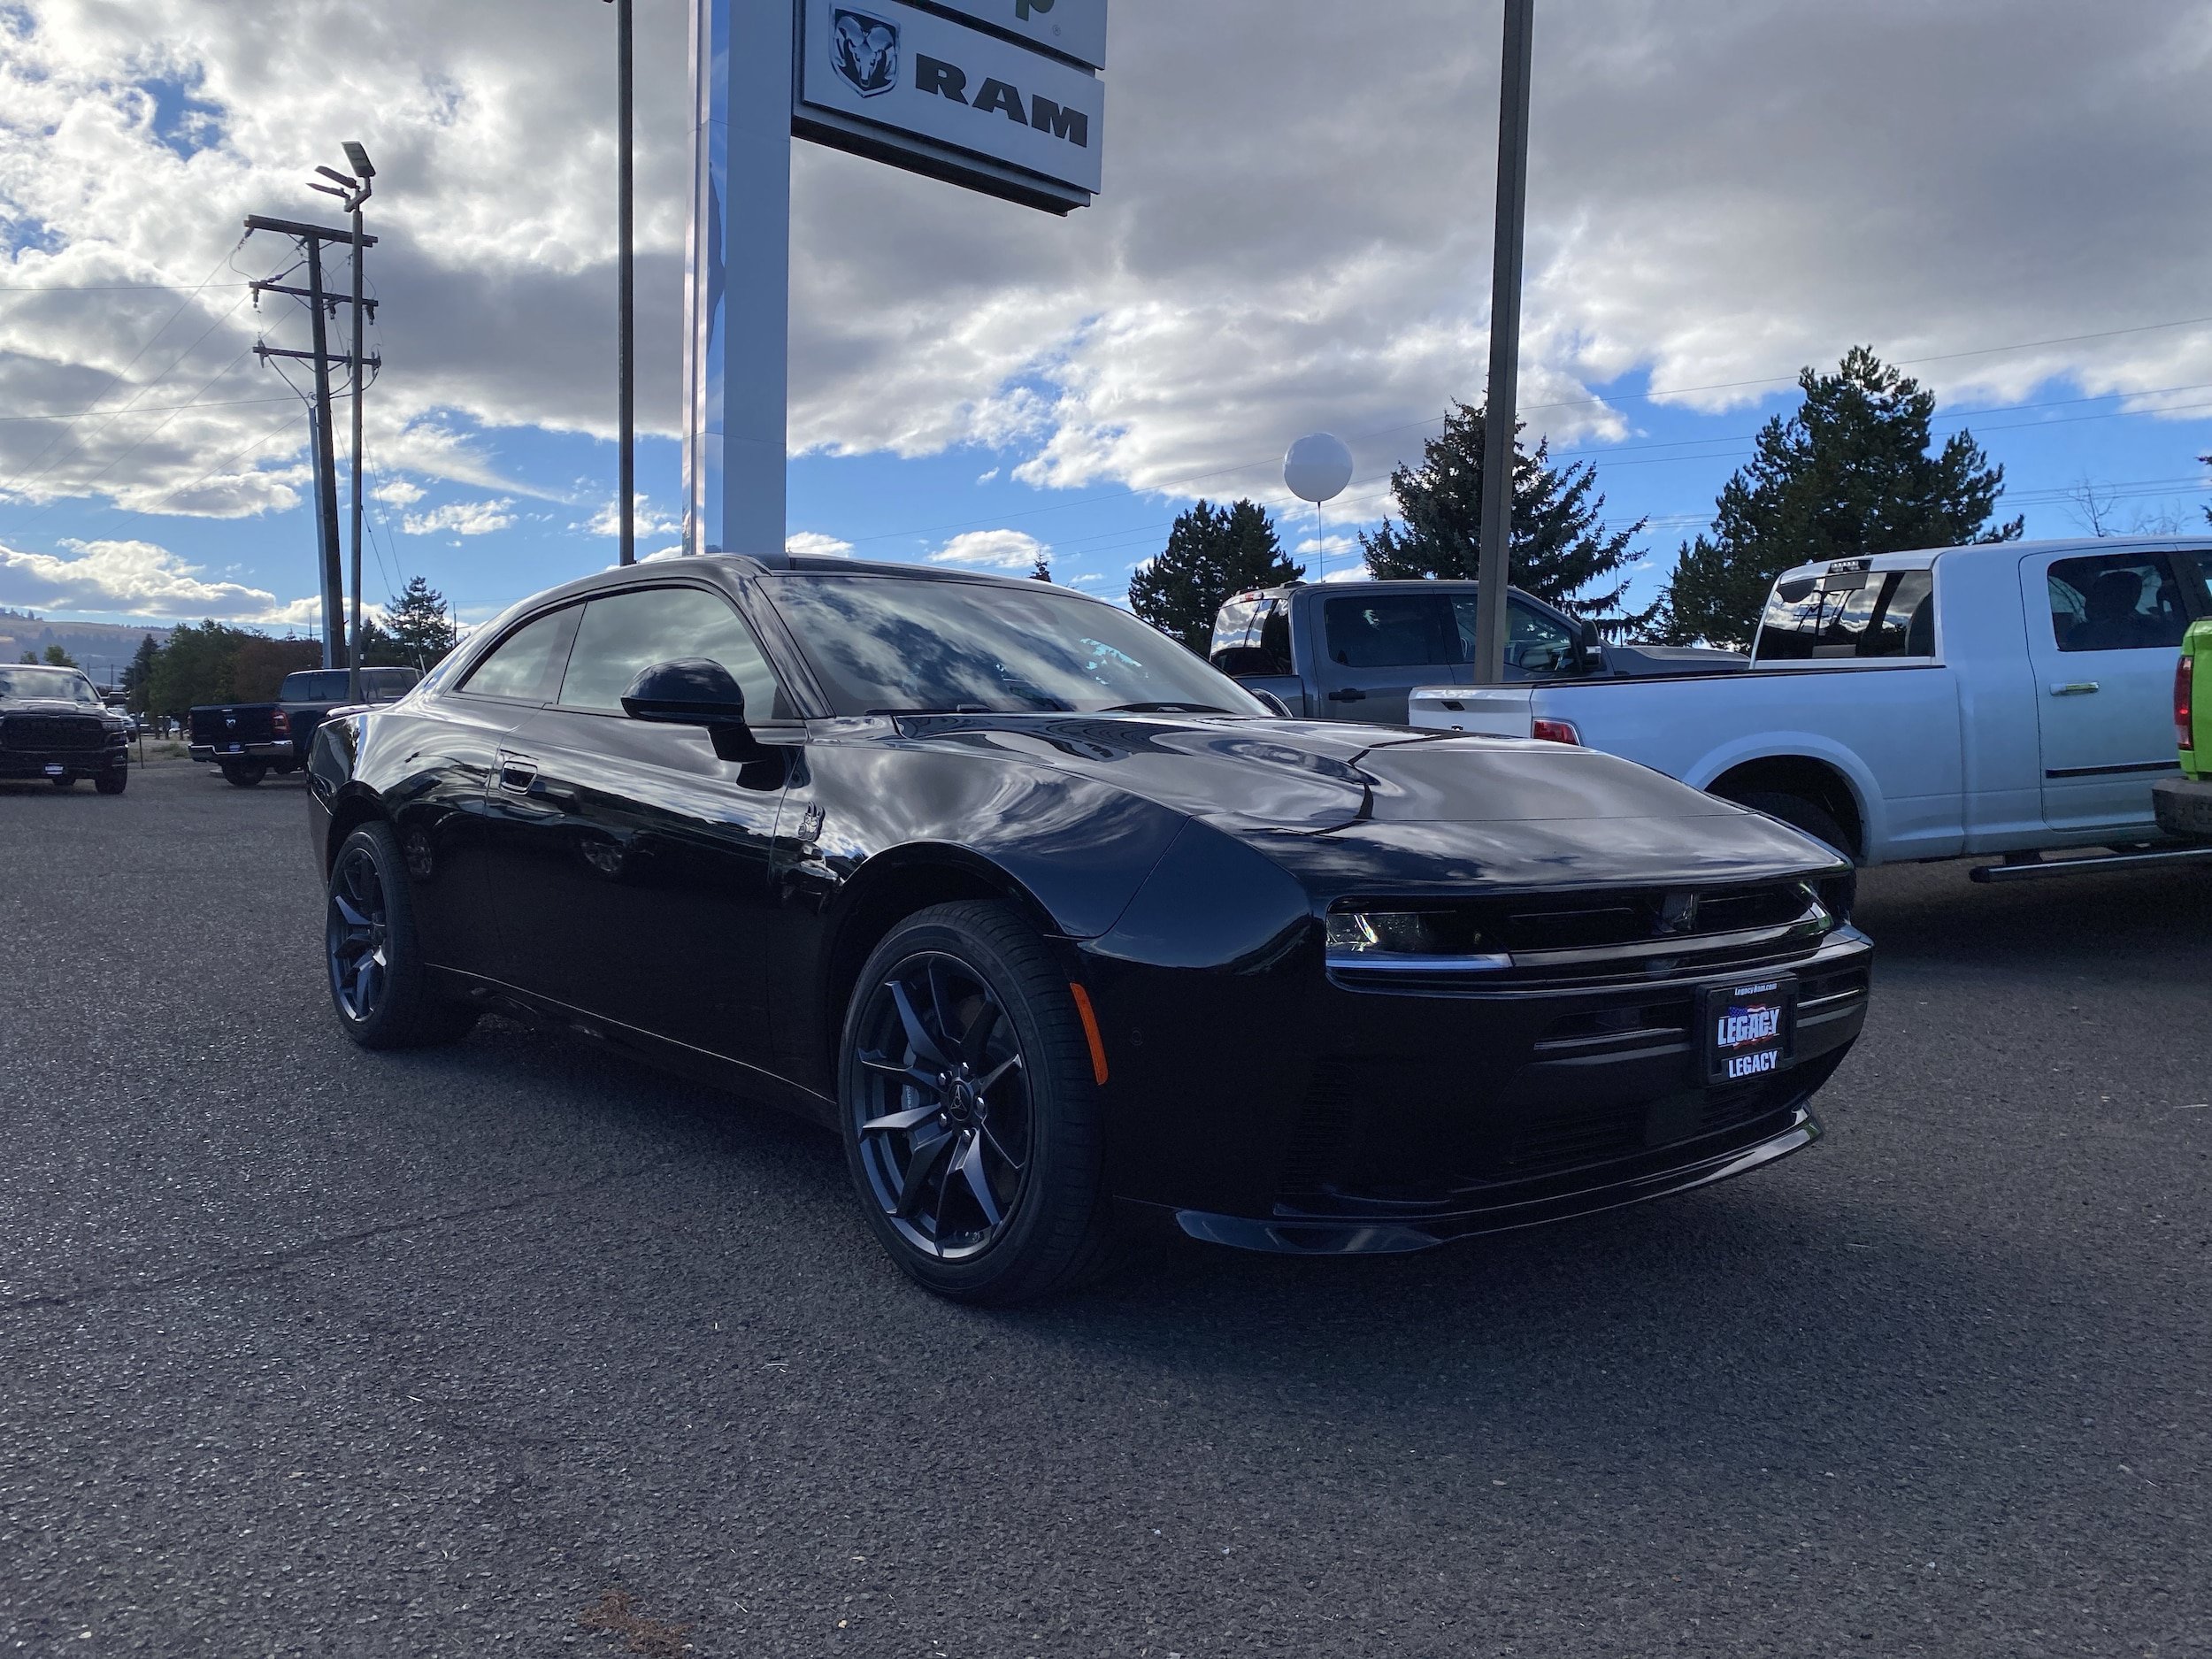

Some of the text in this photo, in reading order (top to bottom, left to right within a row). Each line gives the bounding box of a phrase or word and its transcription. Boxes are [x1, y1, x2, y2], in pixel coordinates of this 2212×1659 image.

[916, 53, 1087, 148] RAM
[1717, 1009, 1780, 1045] LEGACY
[1728, 1050, 1778, 1078] LEGACY
